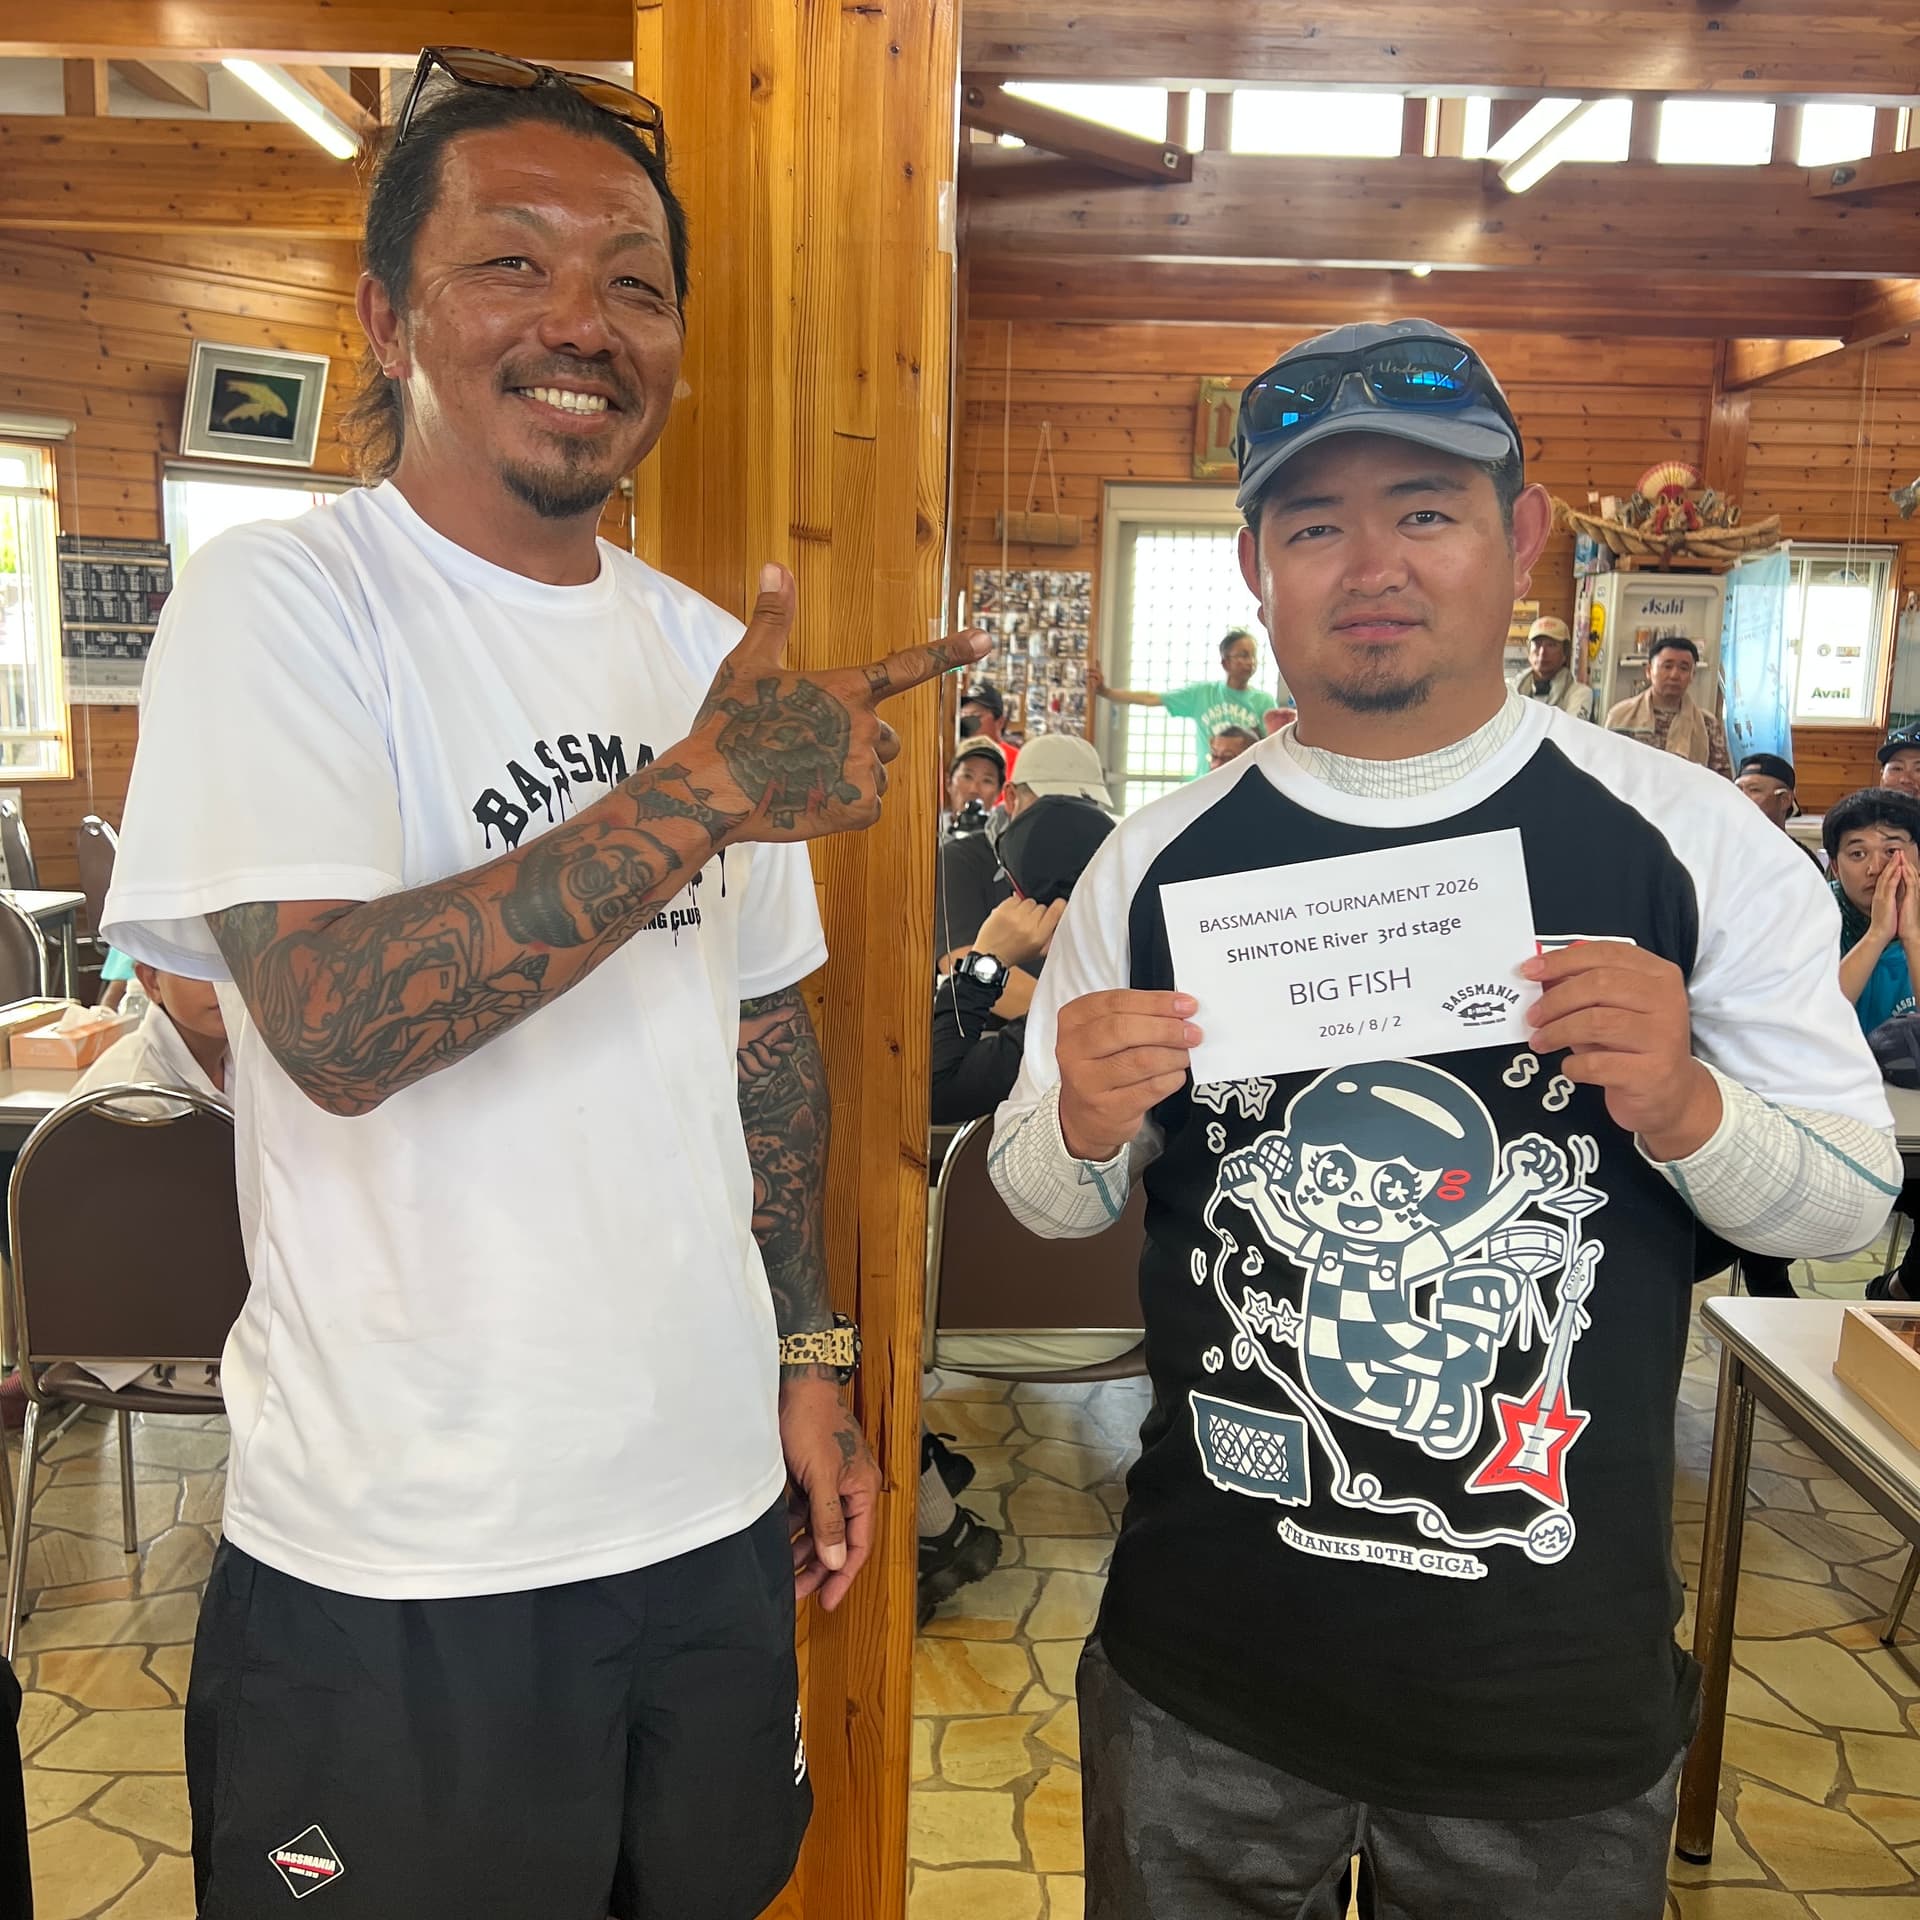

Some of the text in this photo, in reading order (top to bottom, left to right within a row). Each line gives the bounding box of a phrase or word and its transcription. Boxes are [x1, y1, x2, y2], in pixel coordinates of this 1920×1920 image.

[1641, 598, 1684, 615] Asahi
[1811, 687, 1850, 699] Avail
[472, 733, 655, 848] BASSMA
[1199, 877, 1479, 933] BASSMANIA TOURNAMENT 2026
[670, 907, 702, 931] CLUB
[1226, 917, 1462, 964] SHINTONE River 3rd stage
[1289, 966, 1412, 1006] BIG FISH
[1441, 983, 1520, 1012] BASSMANIA
[1319, 1022, 1355, 1038] 2026
[1366, 1544, 1414, 1565] 10TH
[276, 1850, 336, 1872] BASSMANIA
